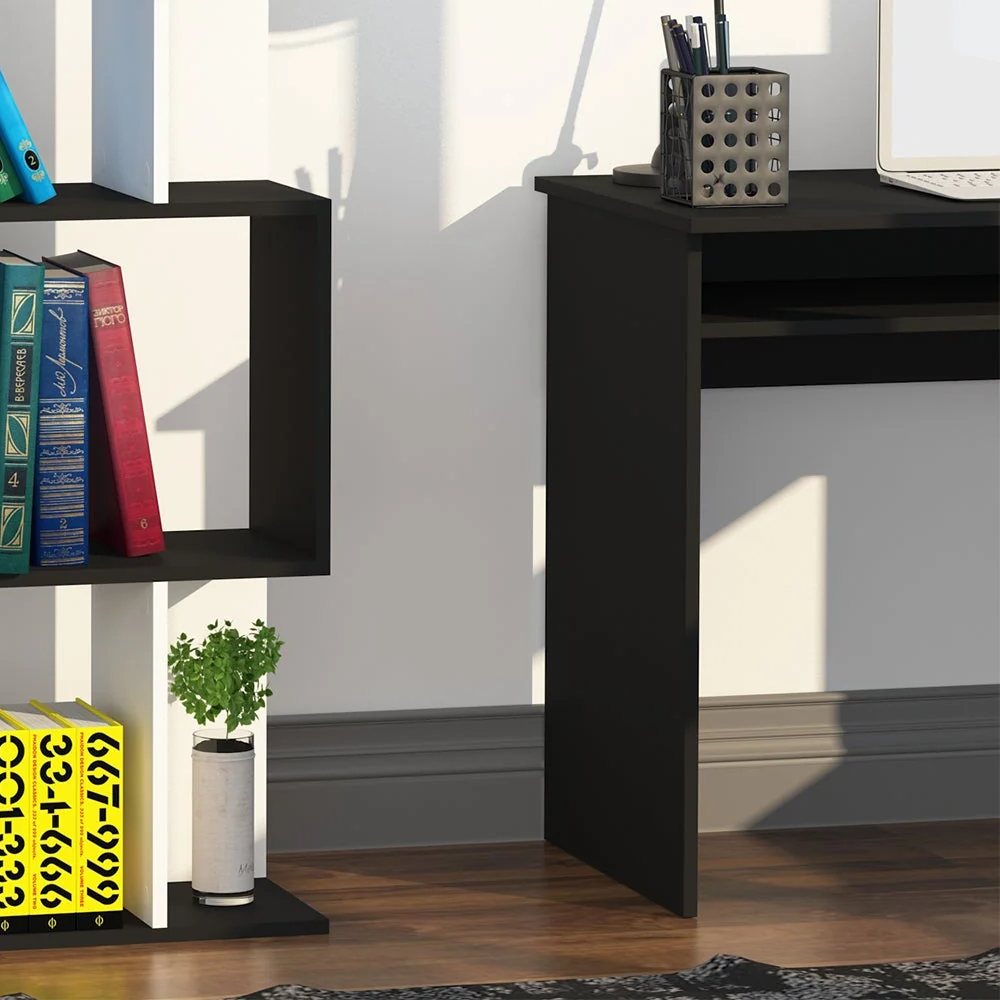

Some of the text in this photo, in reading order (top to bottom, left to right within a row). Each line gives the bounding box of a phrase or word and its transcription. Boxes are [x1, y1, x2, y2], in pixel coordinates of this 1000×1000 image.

[28, 155, 36, 165] 2
[7, 471, 20, 488] 4
[58, 518, 67, 530] 2
[140, 518, 148, 529] 6
